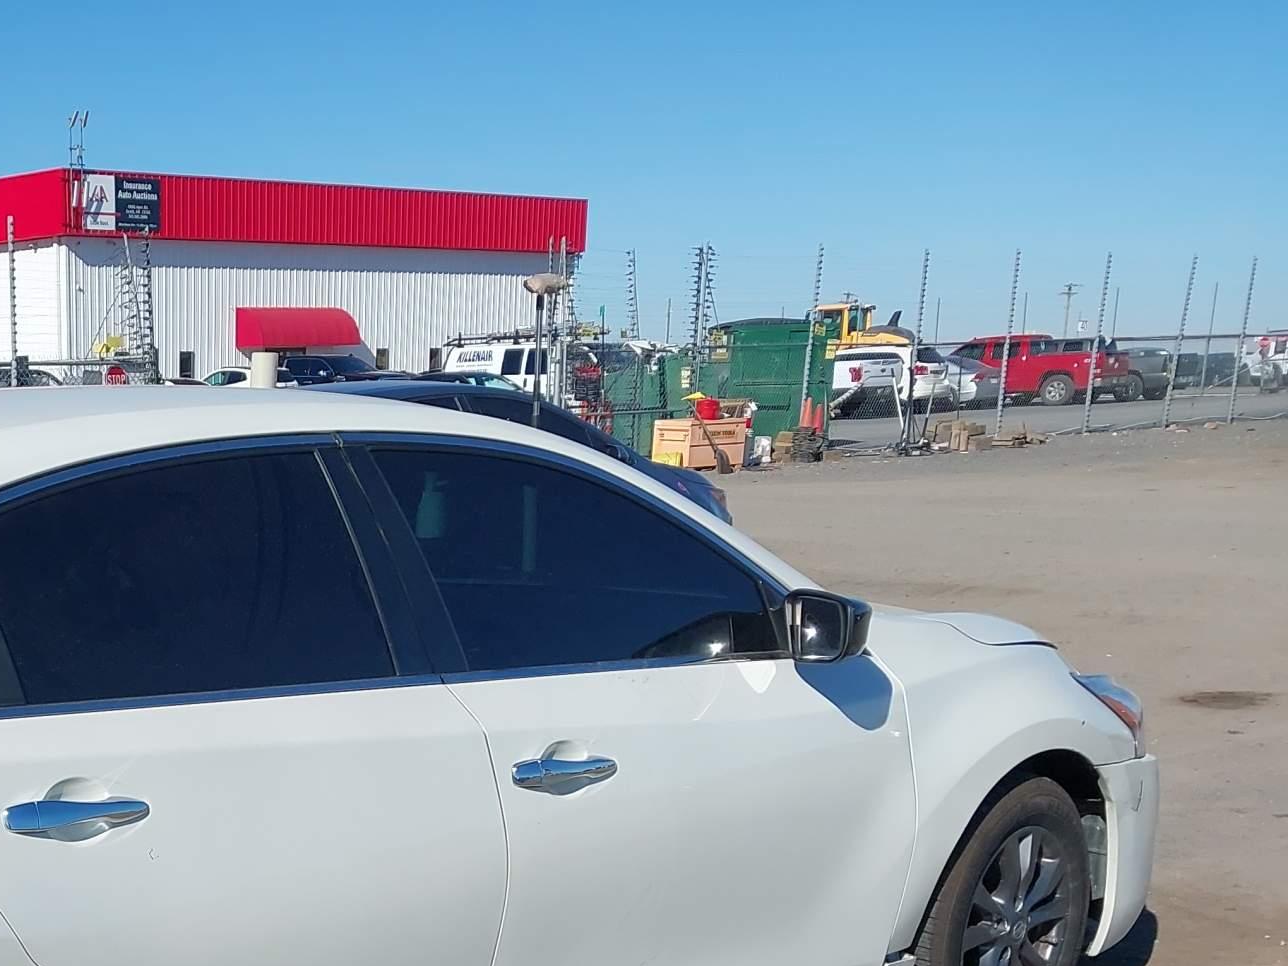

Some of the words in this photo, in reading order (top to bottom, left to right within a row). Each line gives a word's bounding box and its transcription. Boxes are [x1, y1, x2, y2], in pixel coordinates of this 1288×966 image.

[123, 180, 152, 190] Insurance
[118, 190, 132, 199] Auto
[132, 191, 158, 200] Auctions
[456, 350, 493, 363] KILLENAIR
[107, 374, 126, 385] STOP
